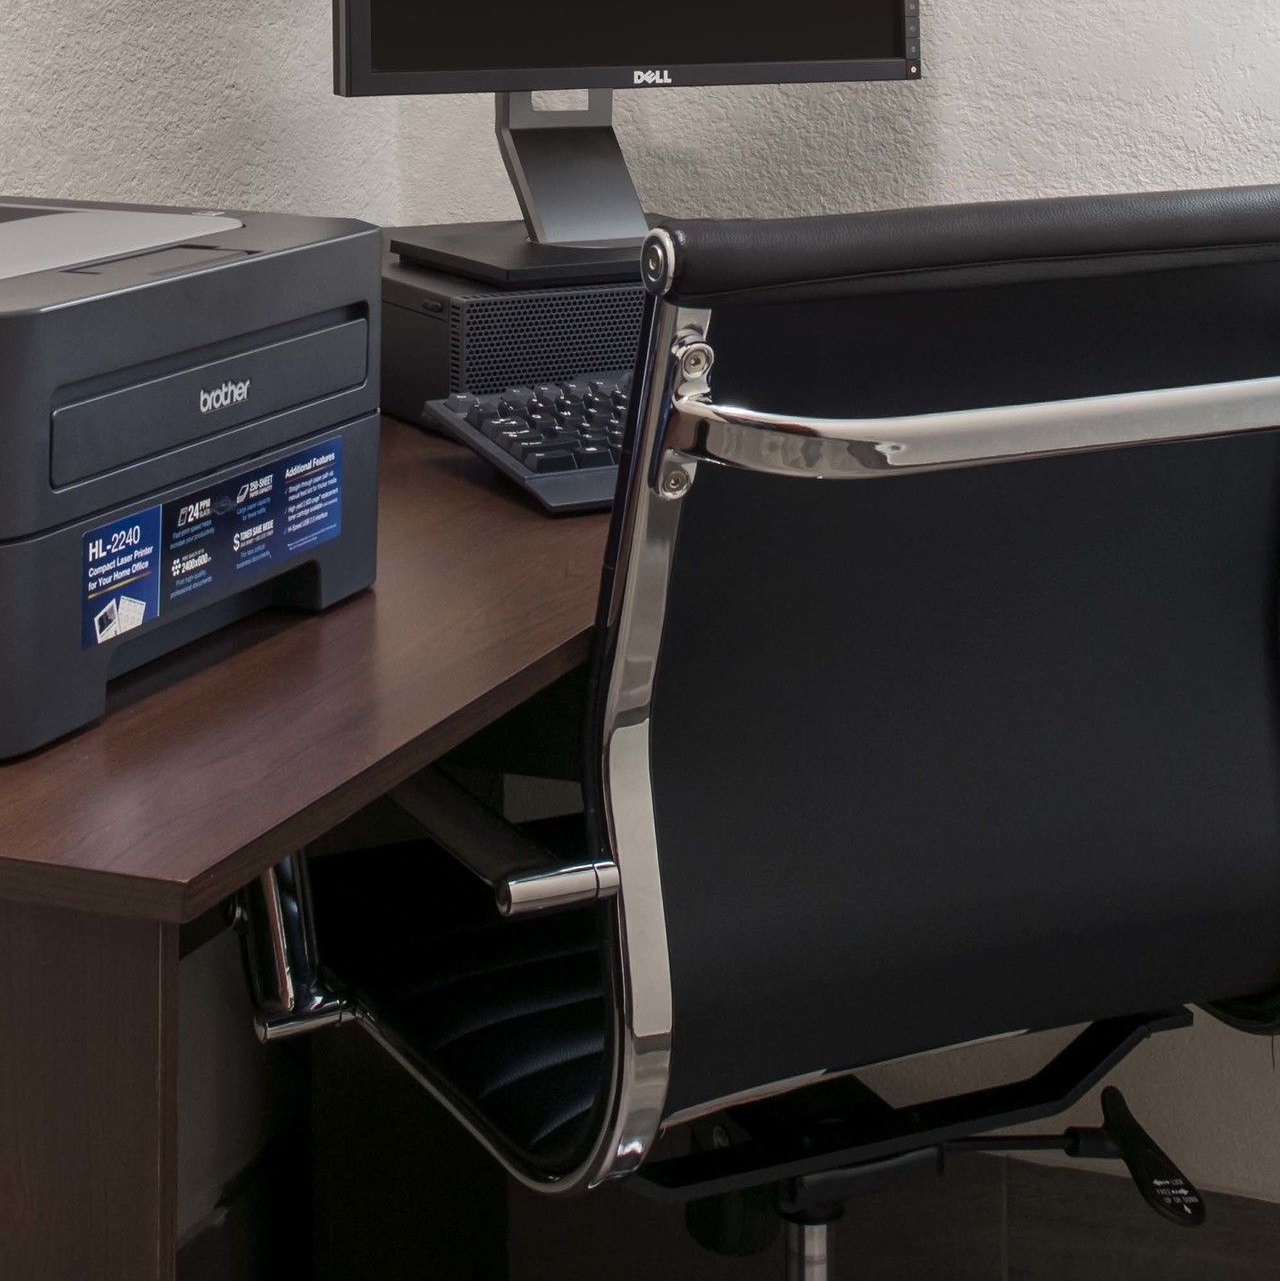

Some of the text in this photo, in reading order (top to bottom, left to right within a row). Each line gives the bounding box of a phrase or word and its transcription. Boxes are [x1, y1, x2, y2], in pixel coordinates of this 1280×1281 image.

[633, 70, 672, 84] DELL
[200, 379, 250, 413] brother
[187, 502, 199, 523] 24
[88, 525, 141, 562] HL-2240
[88, 559, 116, 578] Compact
[88, 581, 97, 591] for
[98, 575, 113, 587] Your
